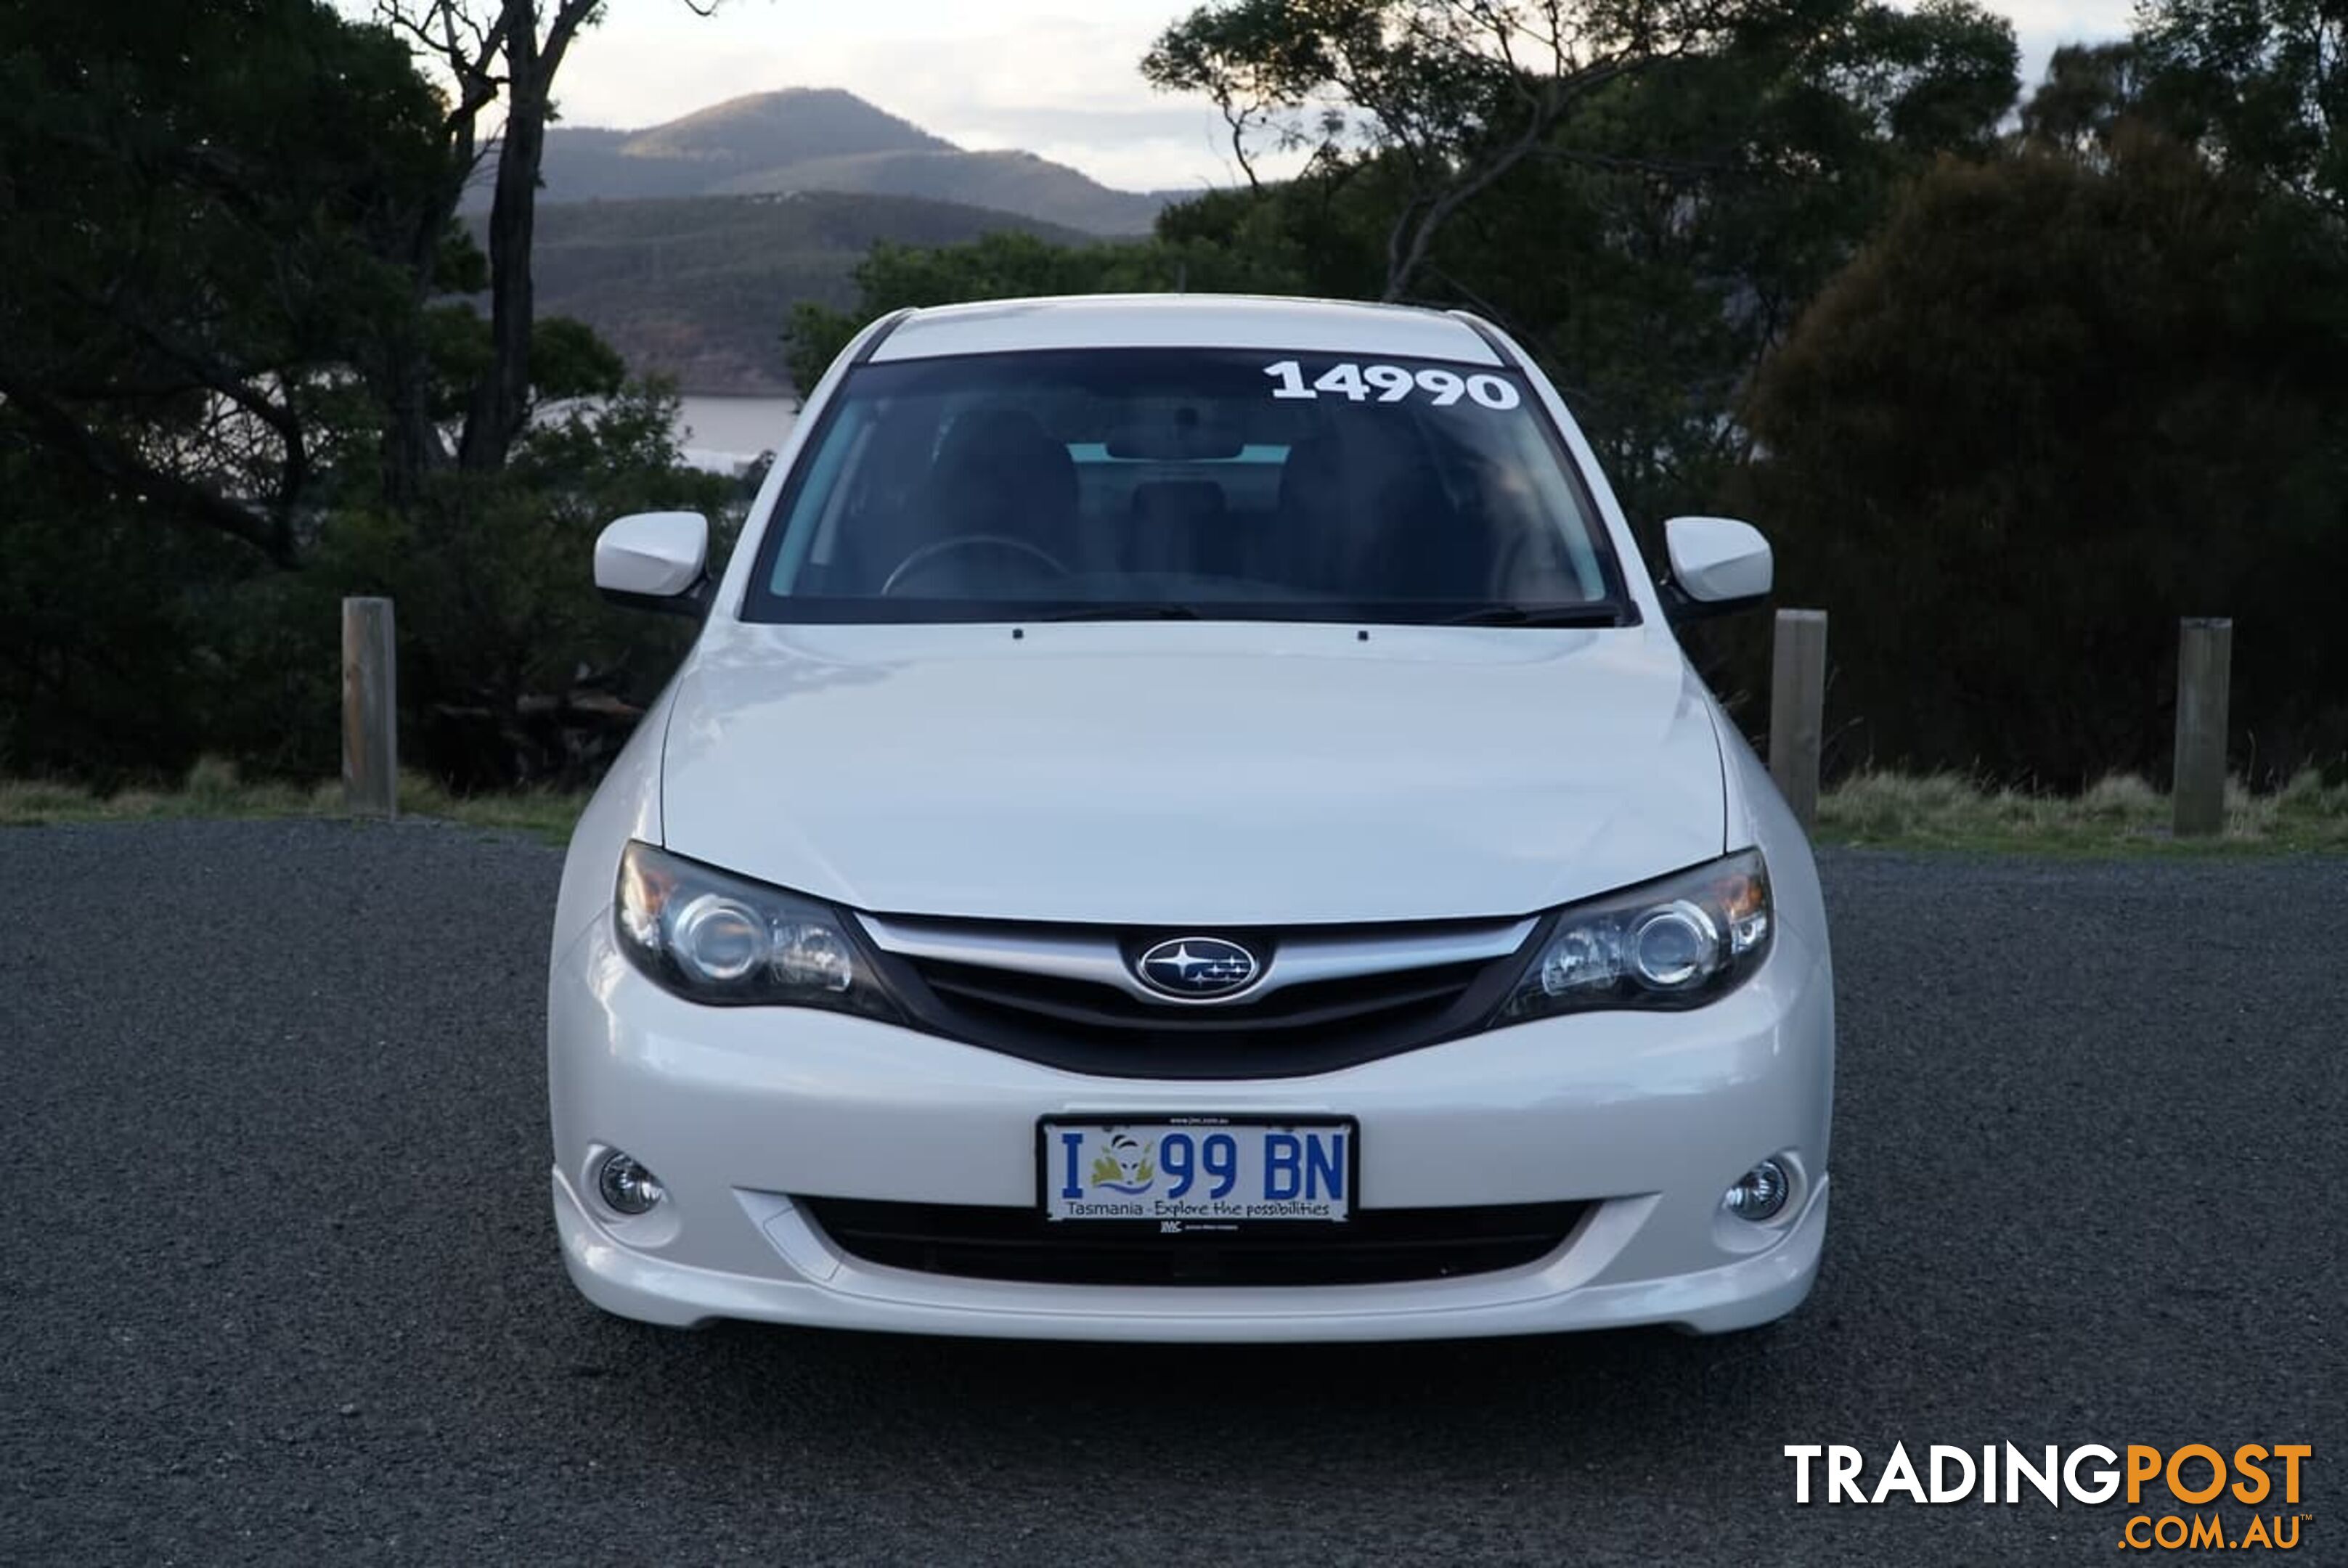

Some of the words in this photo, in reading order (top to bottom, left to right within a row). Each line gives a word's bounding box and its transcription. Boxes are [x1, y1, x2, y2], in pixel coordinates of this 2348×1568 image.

[1263, 361, 1520, 410] 14990
[1161, 1133, 1237, 1199] 99
[1264, 1134, 1343, 1200] BN
[1069, 1201, 1144, 1214] Tasmania
[1155, 1201, 1208, 1217] Explore
[1214, 1201, 1242, 1215] the
[1247, 1201, 1329, 1217] possibilities
